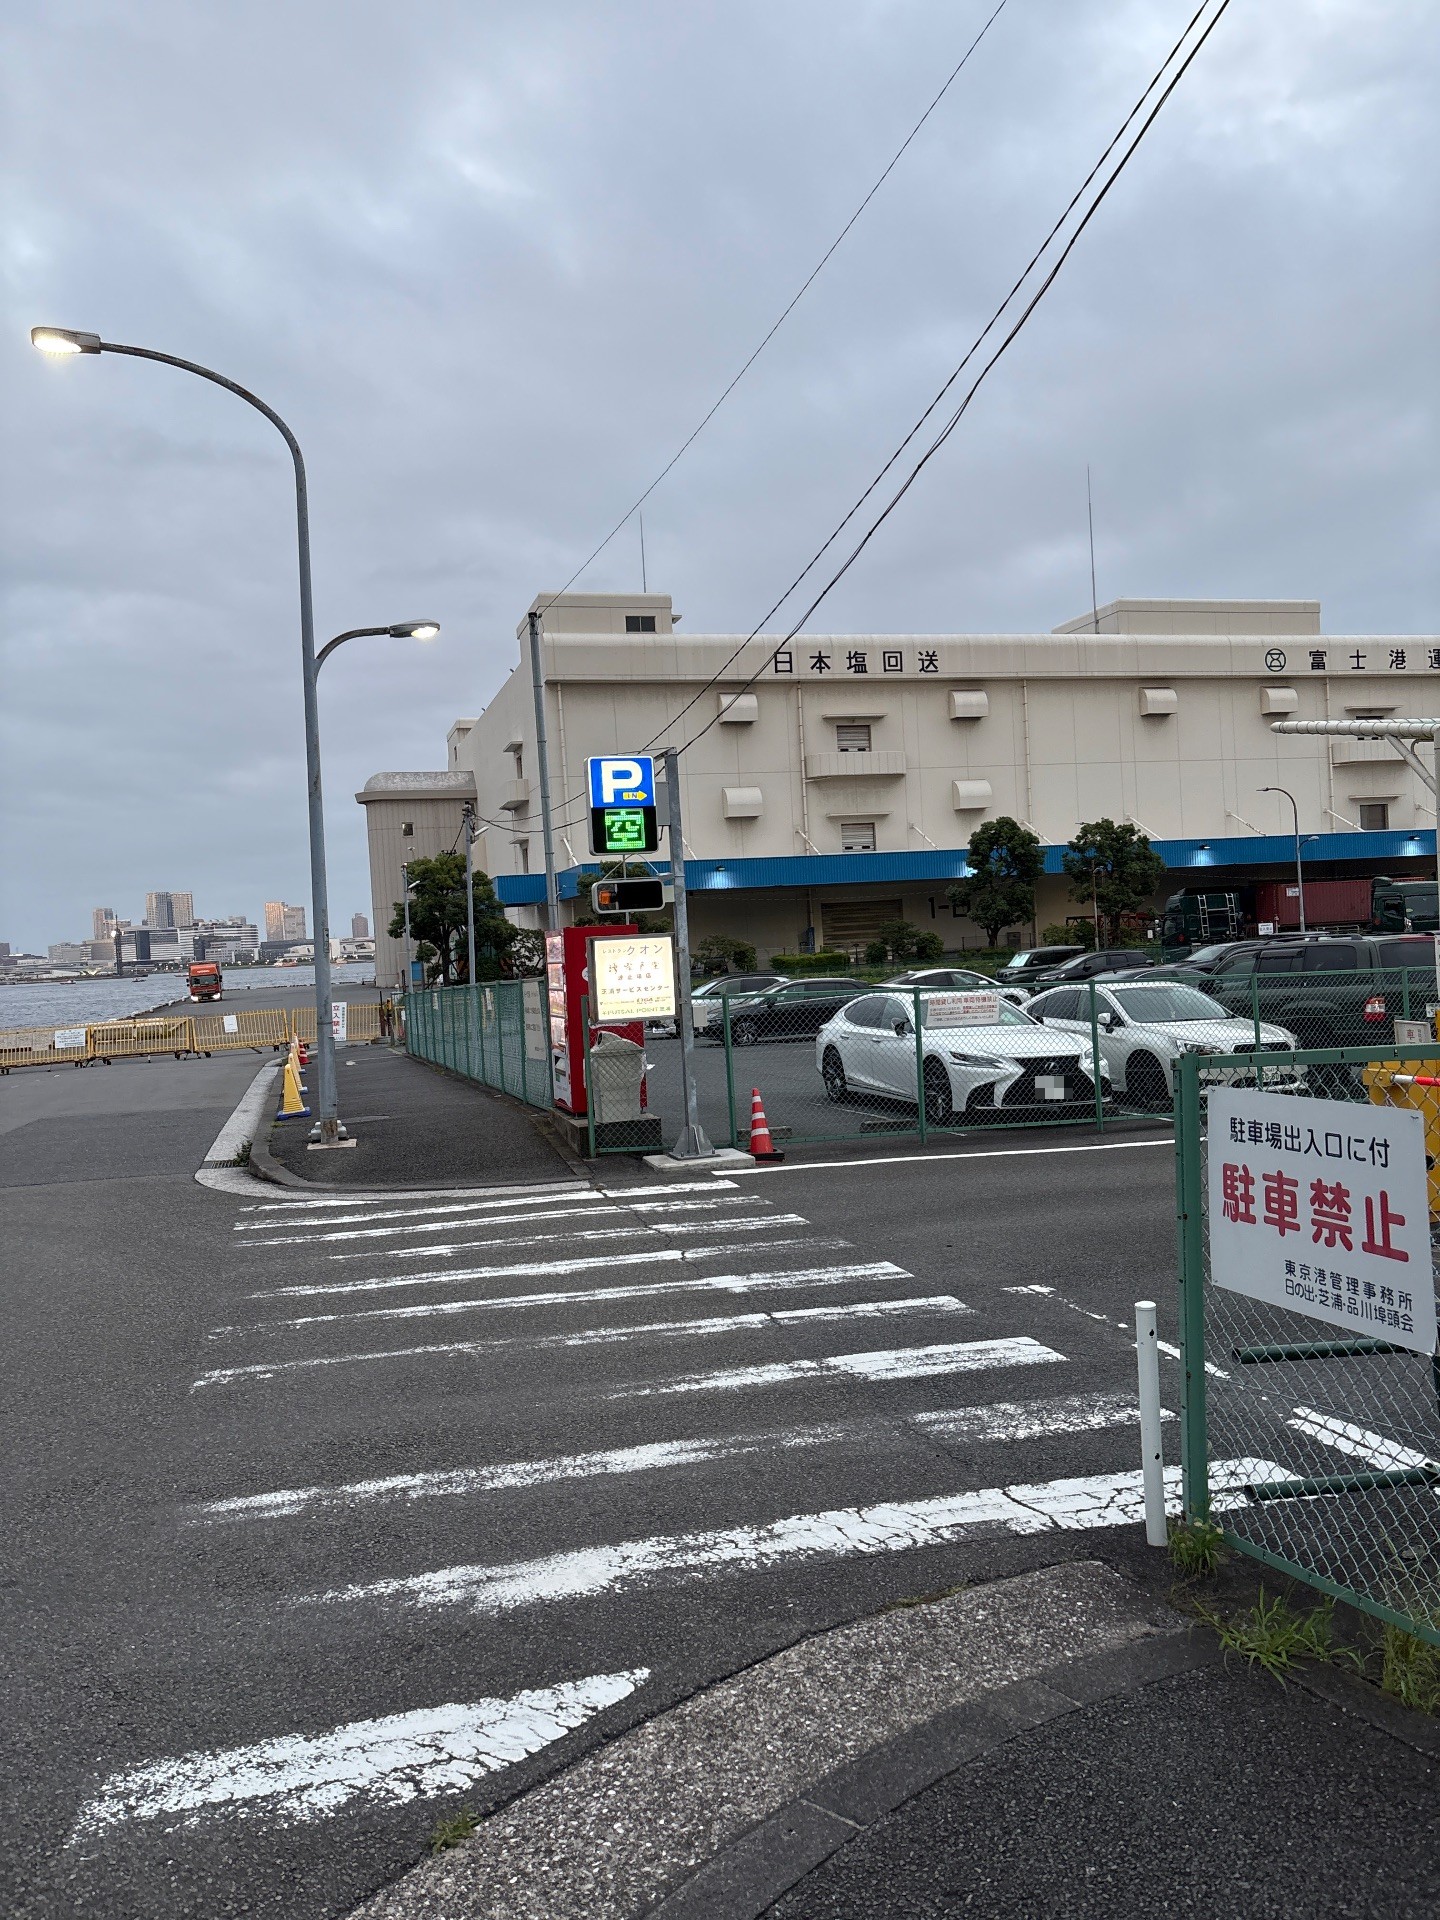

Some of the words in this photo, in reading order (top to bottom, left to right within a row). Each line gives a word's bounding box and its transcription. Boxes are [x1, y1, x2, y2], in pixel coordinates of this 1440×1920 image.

[773, 650, 940, 674] 日本塩回送
[1309, 648, 1440, 670] 富士港運
[600, 760, 643, 803] P
[604, 808, 645, 850] 空
[1229, 1116, 1391, 1169] 駐車場出入口に付
[1221, 1162, 1410, 1263] 駐車禁止
[1284, 1259, 1413, 1312] 東京港管理事務所
